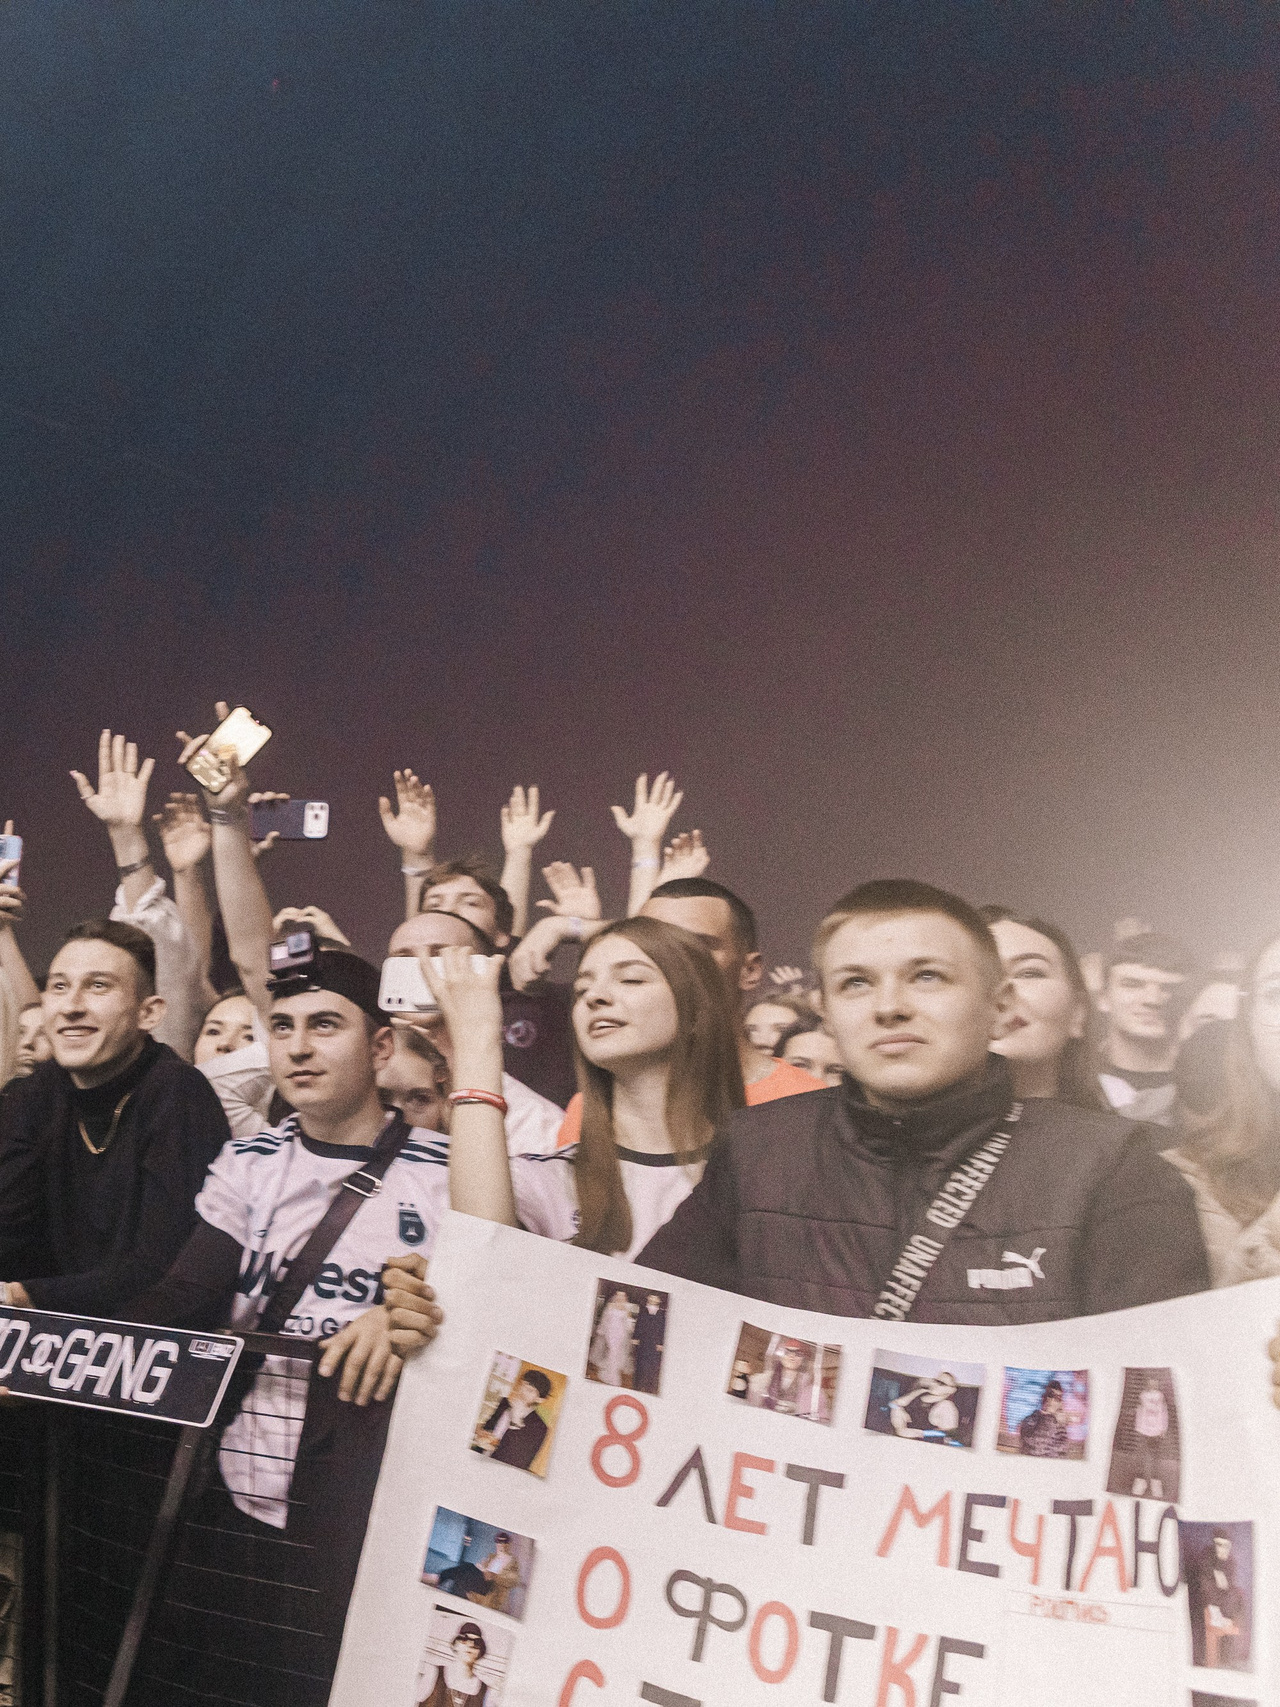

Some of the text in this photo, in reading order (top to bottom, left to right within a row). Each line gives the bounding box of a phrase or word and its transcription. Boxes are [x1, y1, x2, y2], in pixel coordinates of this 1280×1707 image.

[48, 1328, 179, 1404] GANG
[590, 1394, 1182, 1597] 8 ЛЕТ МЕЧТАЮ
[577, 1545, 631, 1629] О
